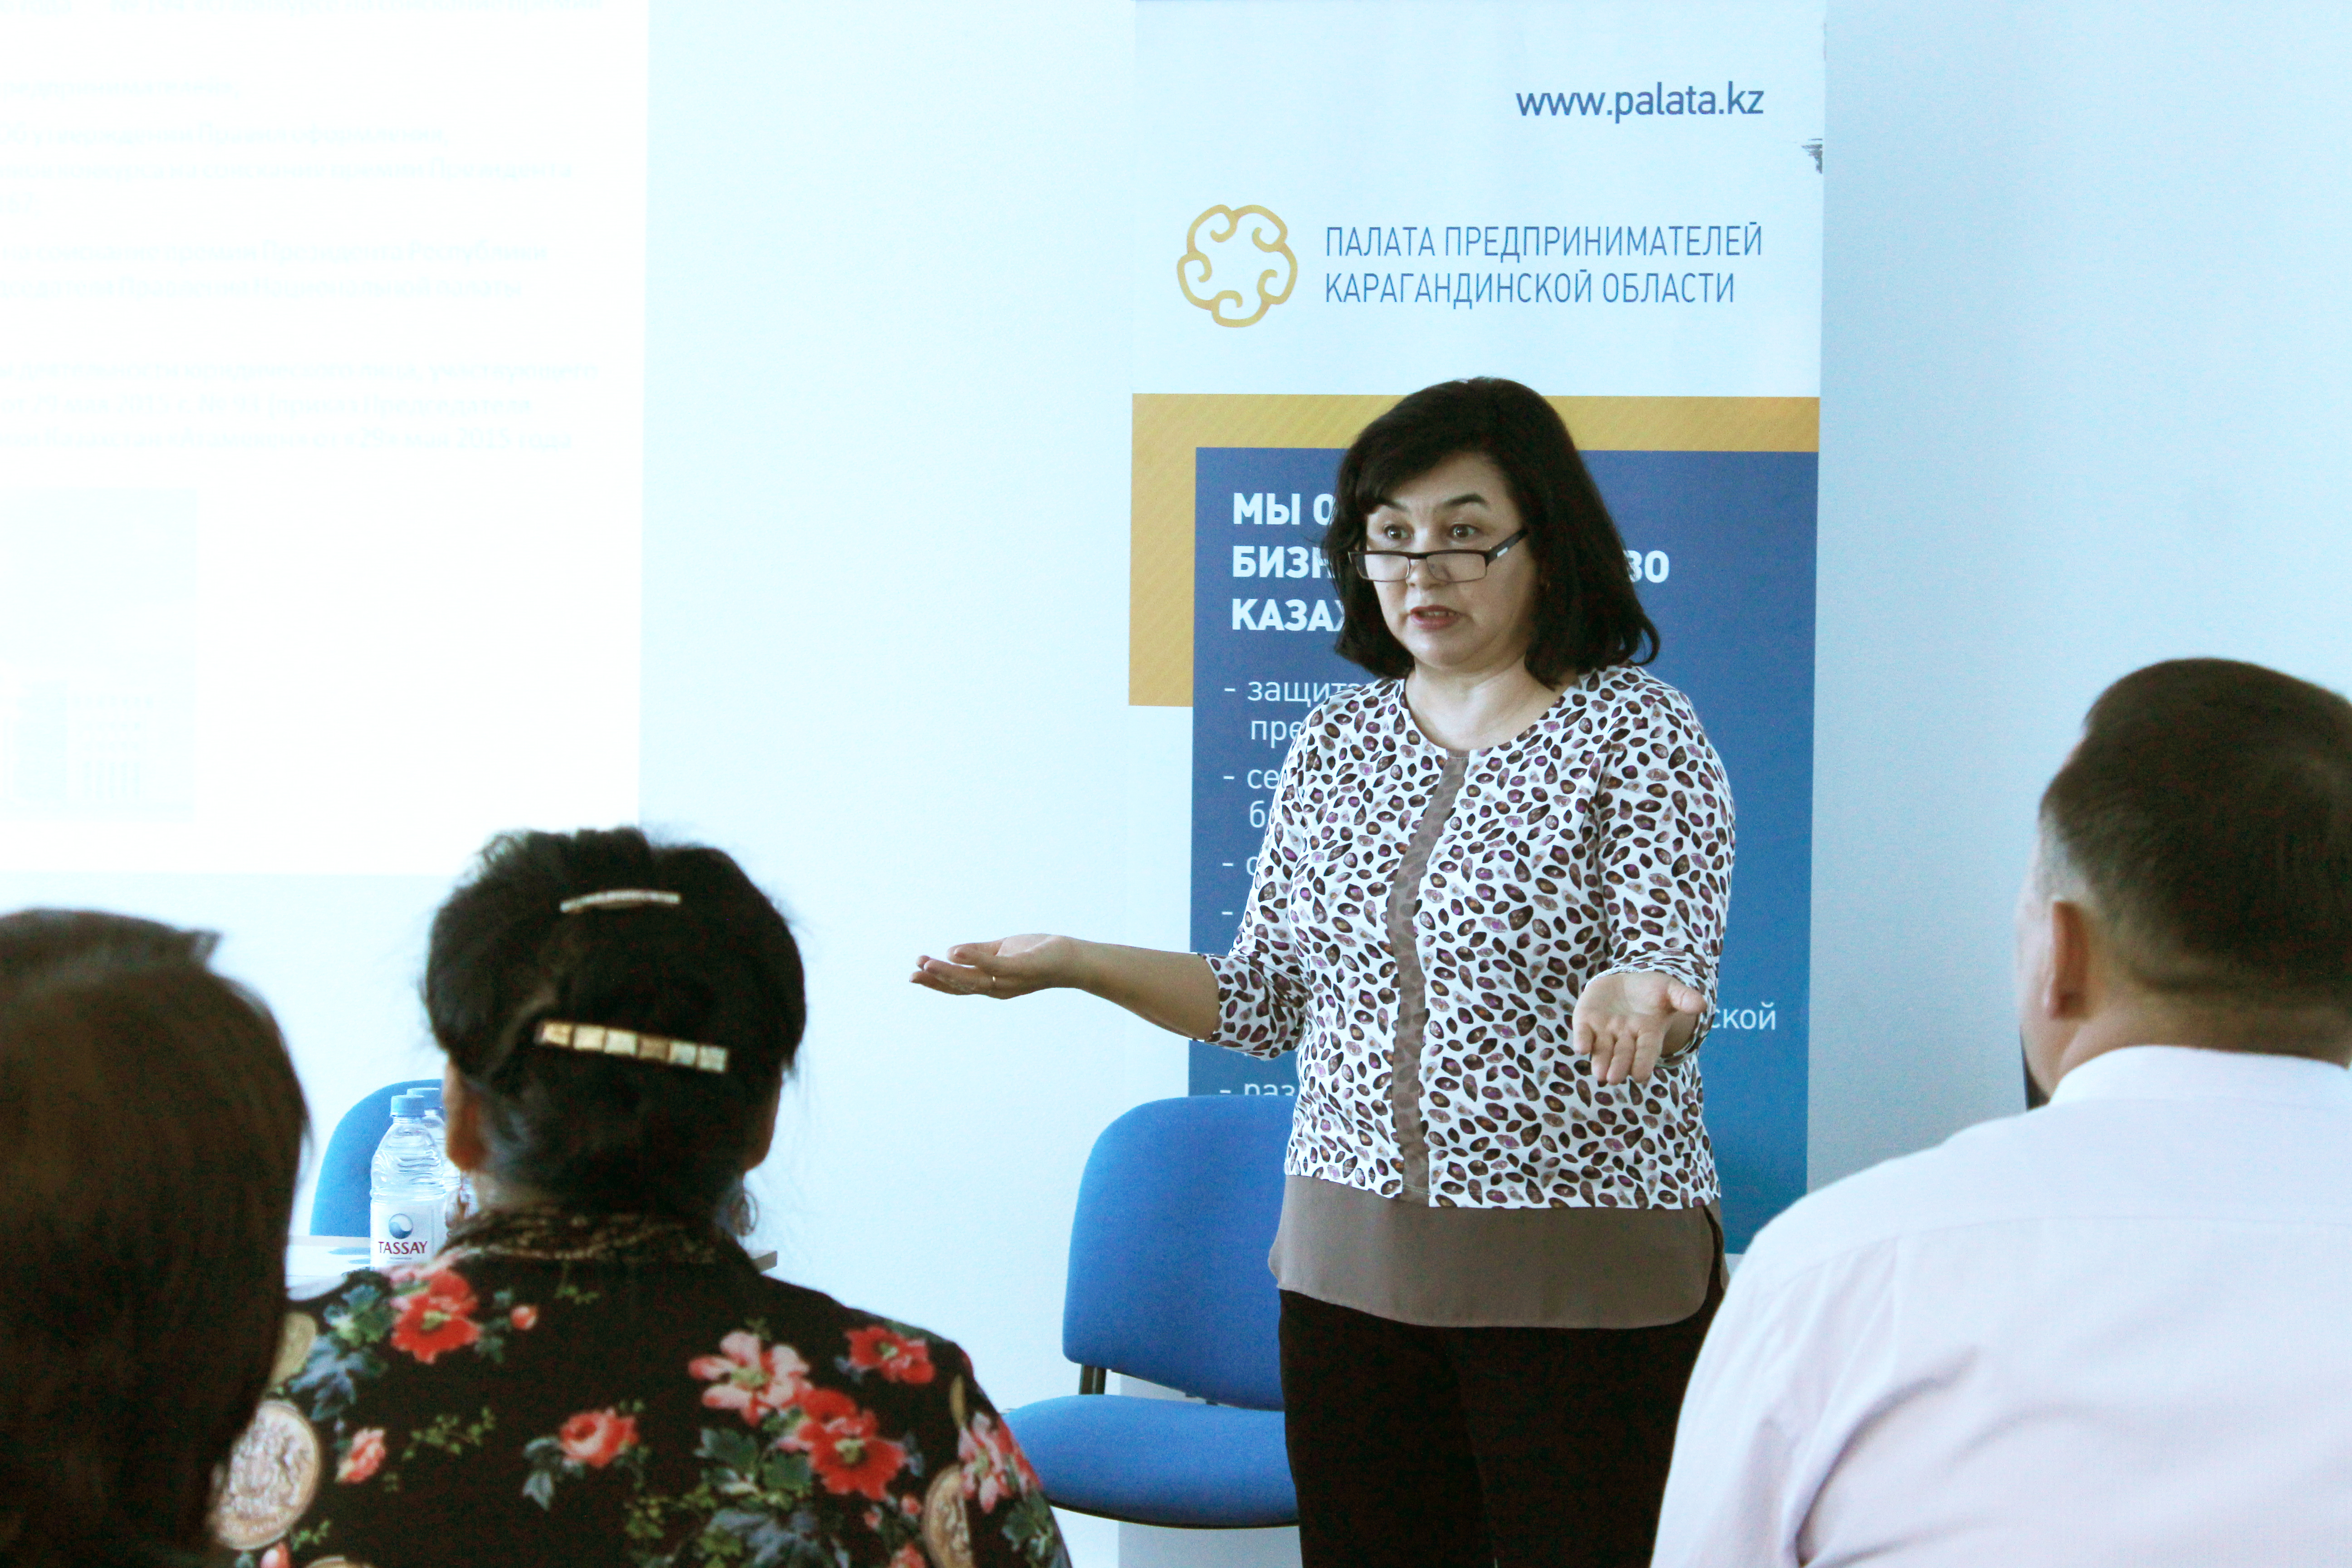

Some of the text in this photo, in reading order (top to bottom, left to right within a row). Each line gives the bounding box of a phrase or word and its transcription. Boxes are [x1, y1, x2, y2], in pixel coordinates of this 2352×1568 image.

[1516, 80, 1764, 124] www.palata.kz
[1326, 221, 1762, 264] ПАЛАТА ПРЕДПРИНИМАТЕЛЕЙ
[1326, 269, 1734, 310] КАРАГАНДИНСКОЙ ОБЛАСТИ
[1234, 493, 1300, 525] МЫ
[1248, 681, 1360, 708] защи
[378, 1241, 428, 1254] TASSAY
